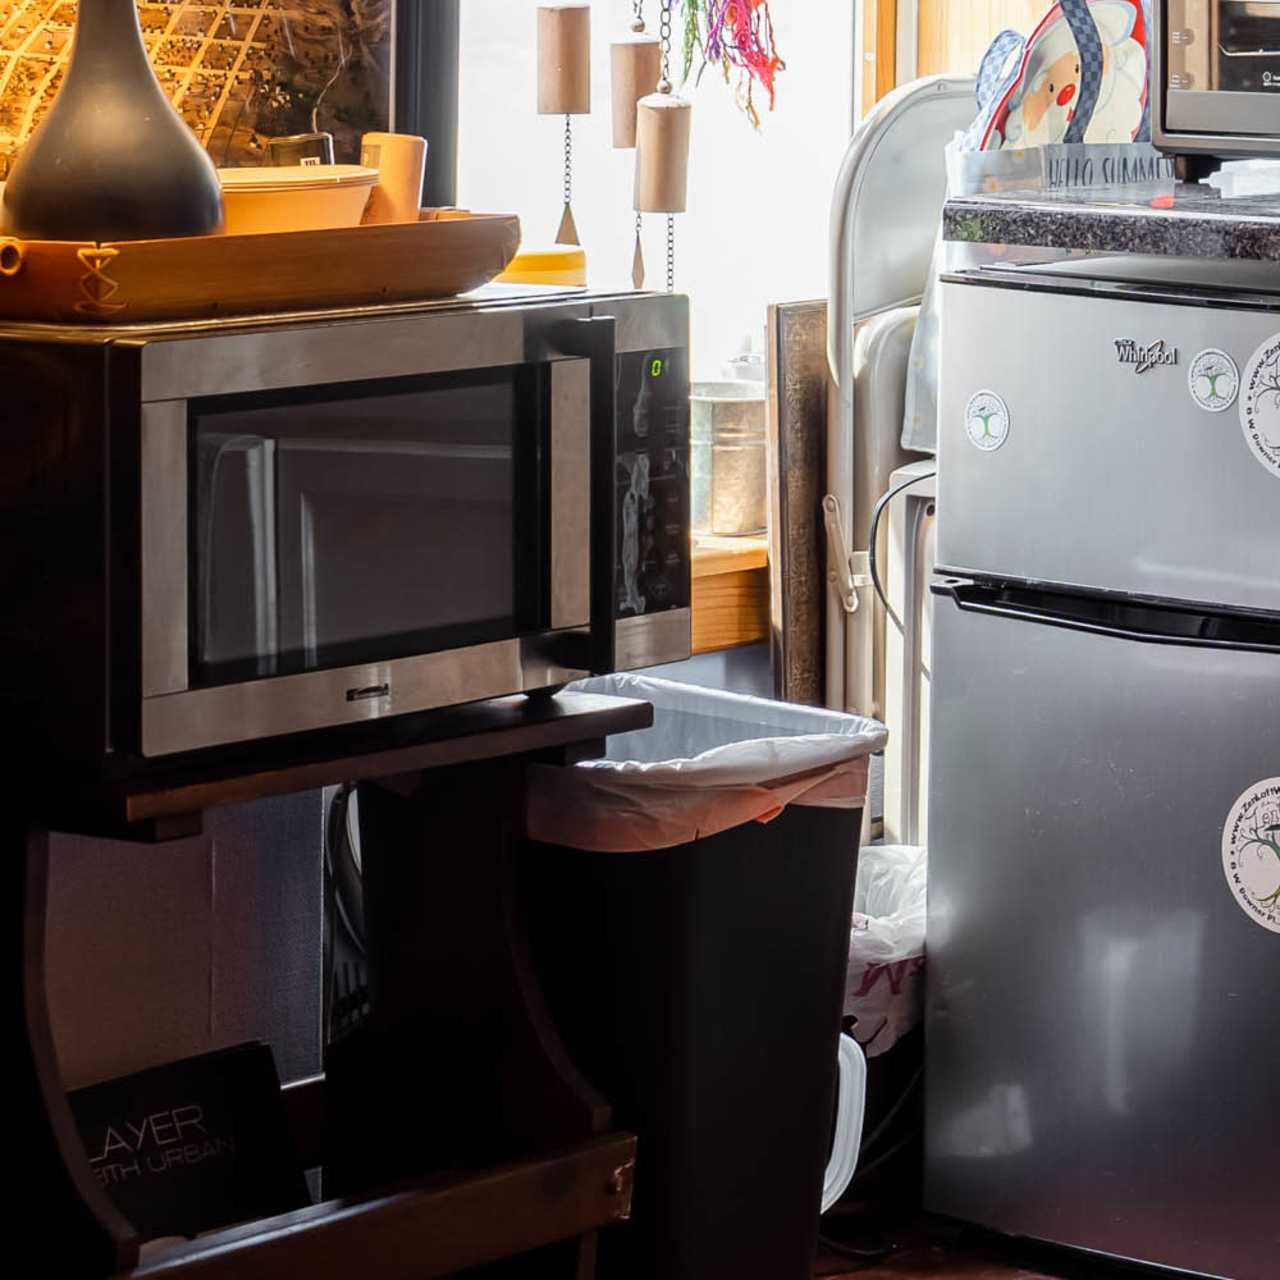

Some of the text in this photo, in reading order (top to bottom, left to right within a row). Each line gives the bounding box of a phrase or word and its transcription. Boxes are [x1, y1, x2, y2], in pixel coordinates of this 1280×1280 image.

[651, 359, 662, 377] 0
[1115, 340, 1178, 371] Whirlpool
[146, 1136, 236, 1174] URBAN
